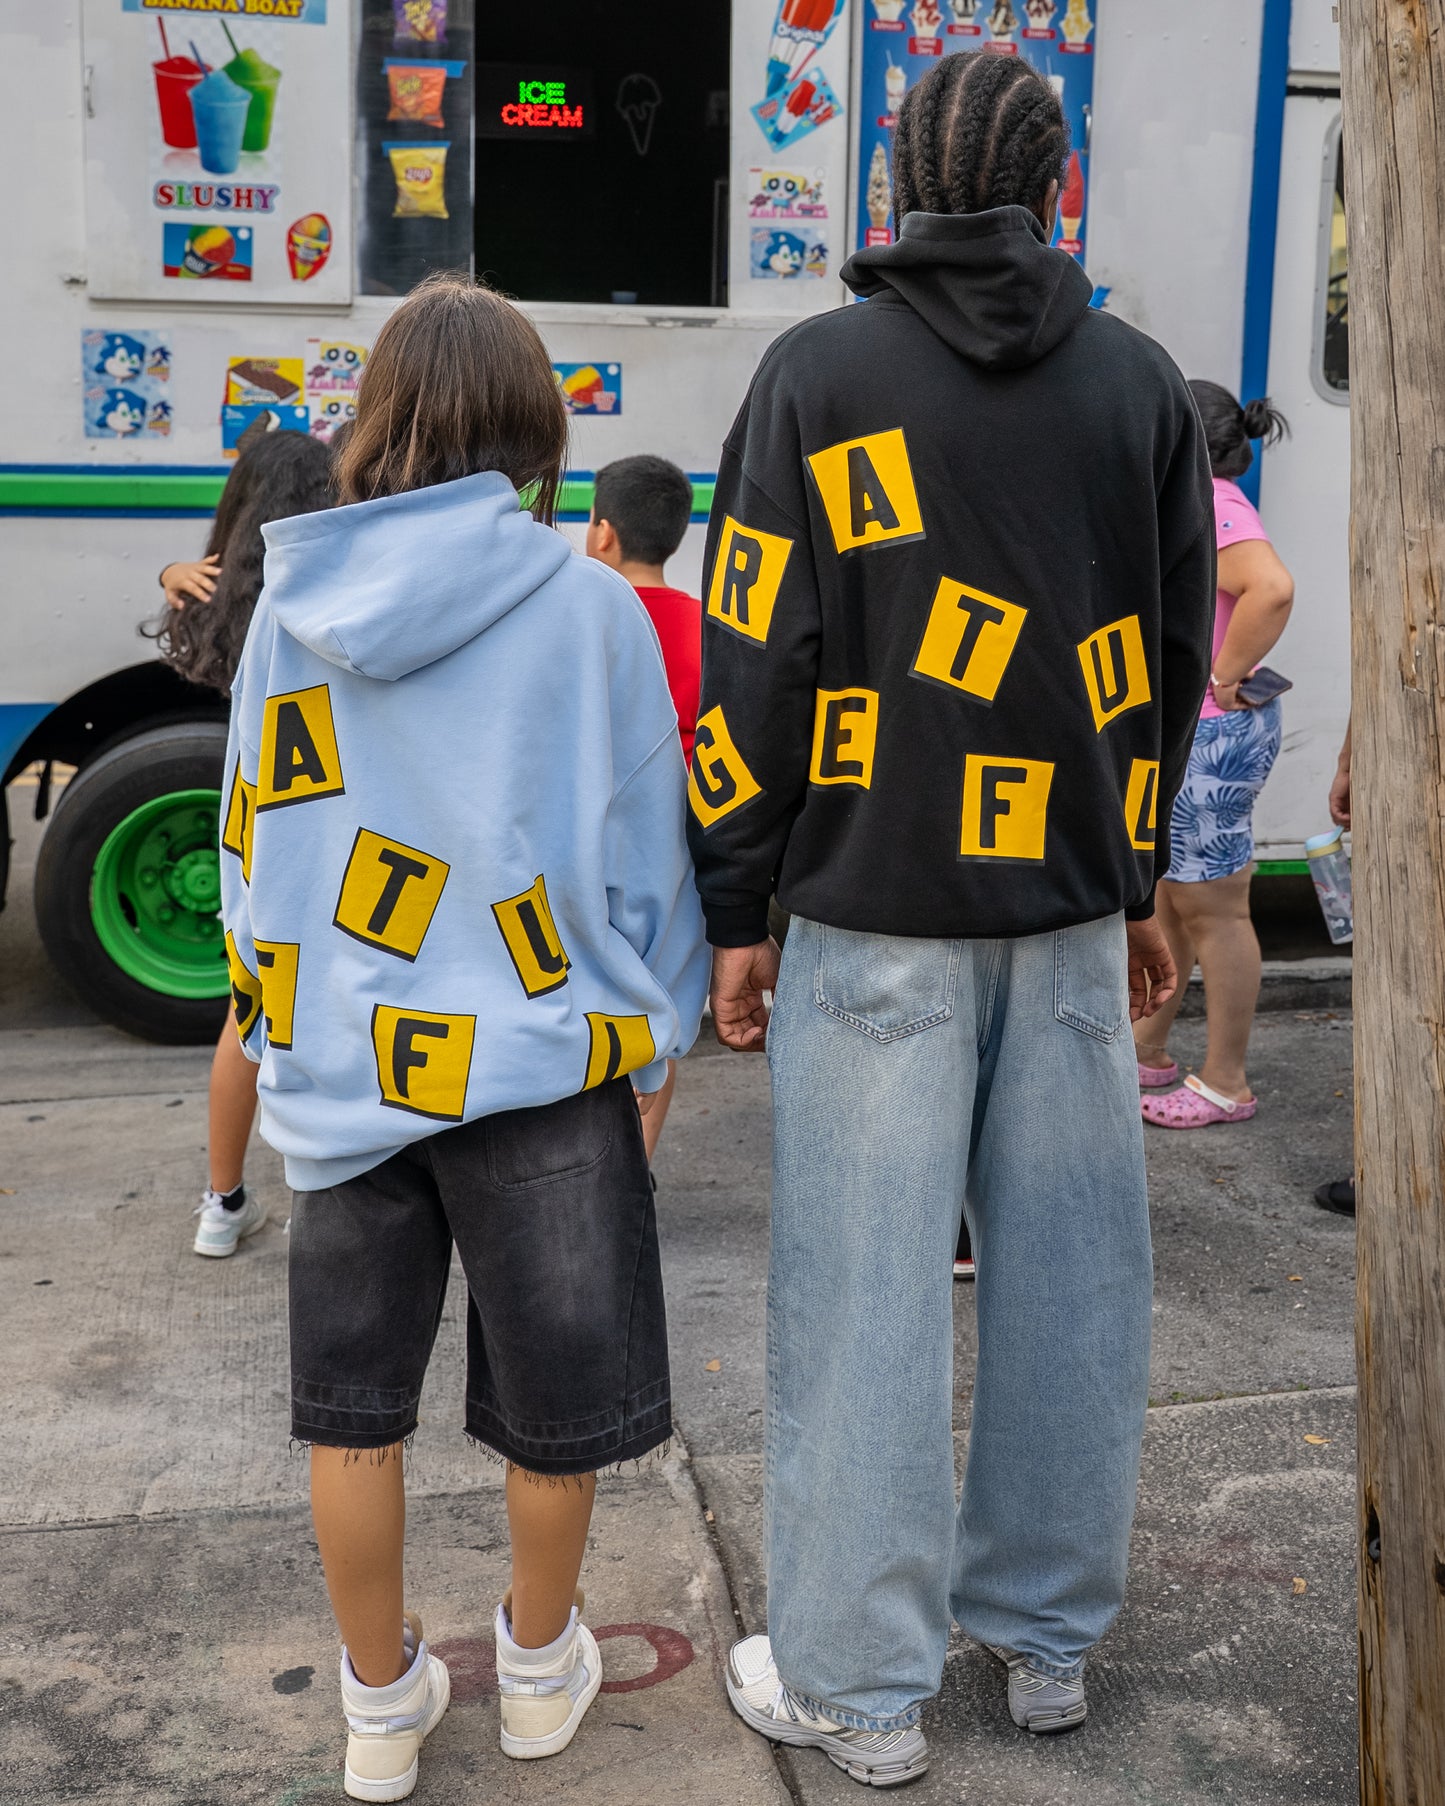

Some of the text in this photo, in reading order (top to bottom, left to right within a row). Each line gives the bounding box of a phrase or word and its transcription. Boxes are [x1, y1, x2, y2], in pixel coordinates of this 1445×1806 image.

[142, 0, 303, 17] BANANA BOAT
[501, 104, 583, 127] CREAM
[519, 81, 566, 104] ICE
[157, 184, 275, 209] SLUSHY
[847, 446, 901, 538] A
[722, 530, 763, 626] R
[950, 594, 1006, 682] T
[1090, 628, 1130, 714] U
[272, 701, 327, 792] A
[692, 725, 737, 809] G
[819, 696, 868, 778] E
[979, 766, 1028, 849] F
[367, 847, 429, 935] T
[393, 1017, 449, 1099] F
